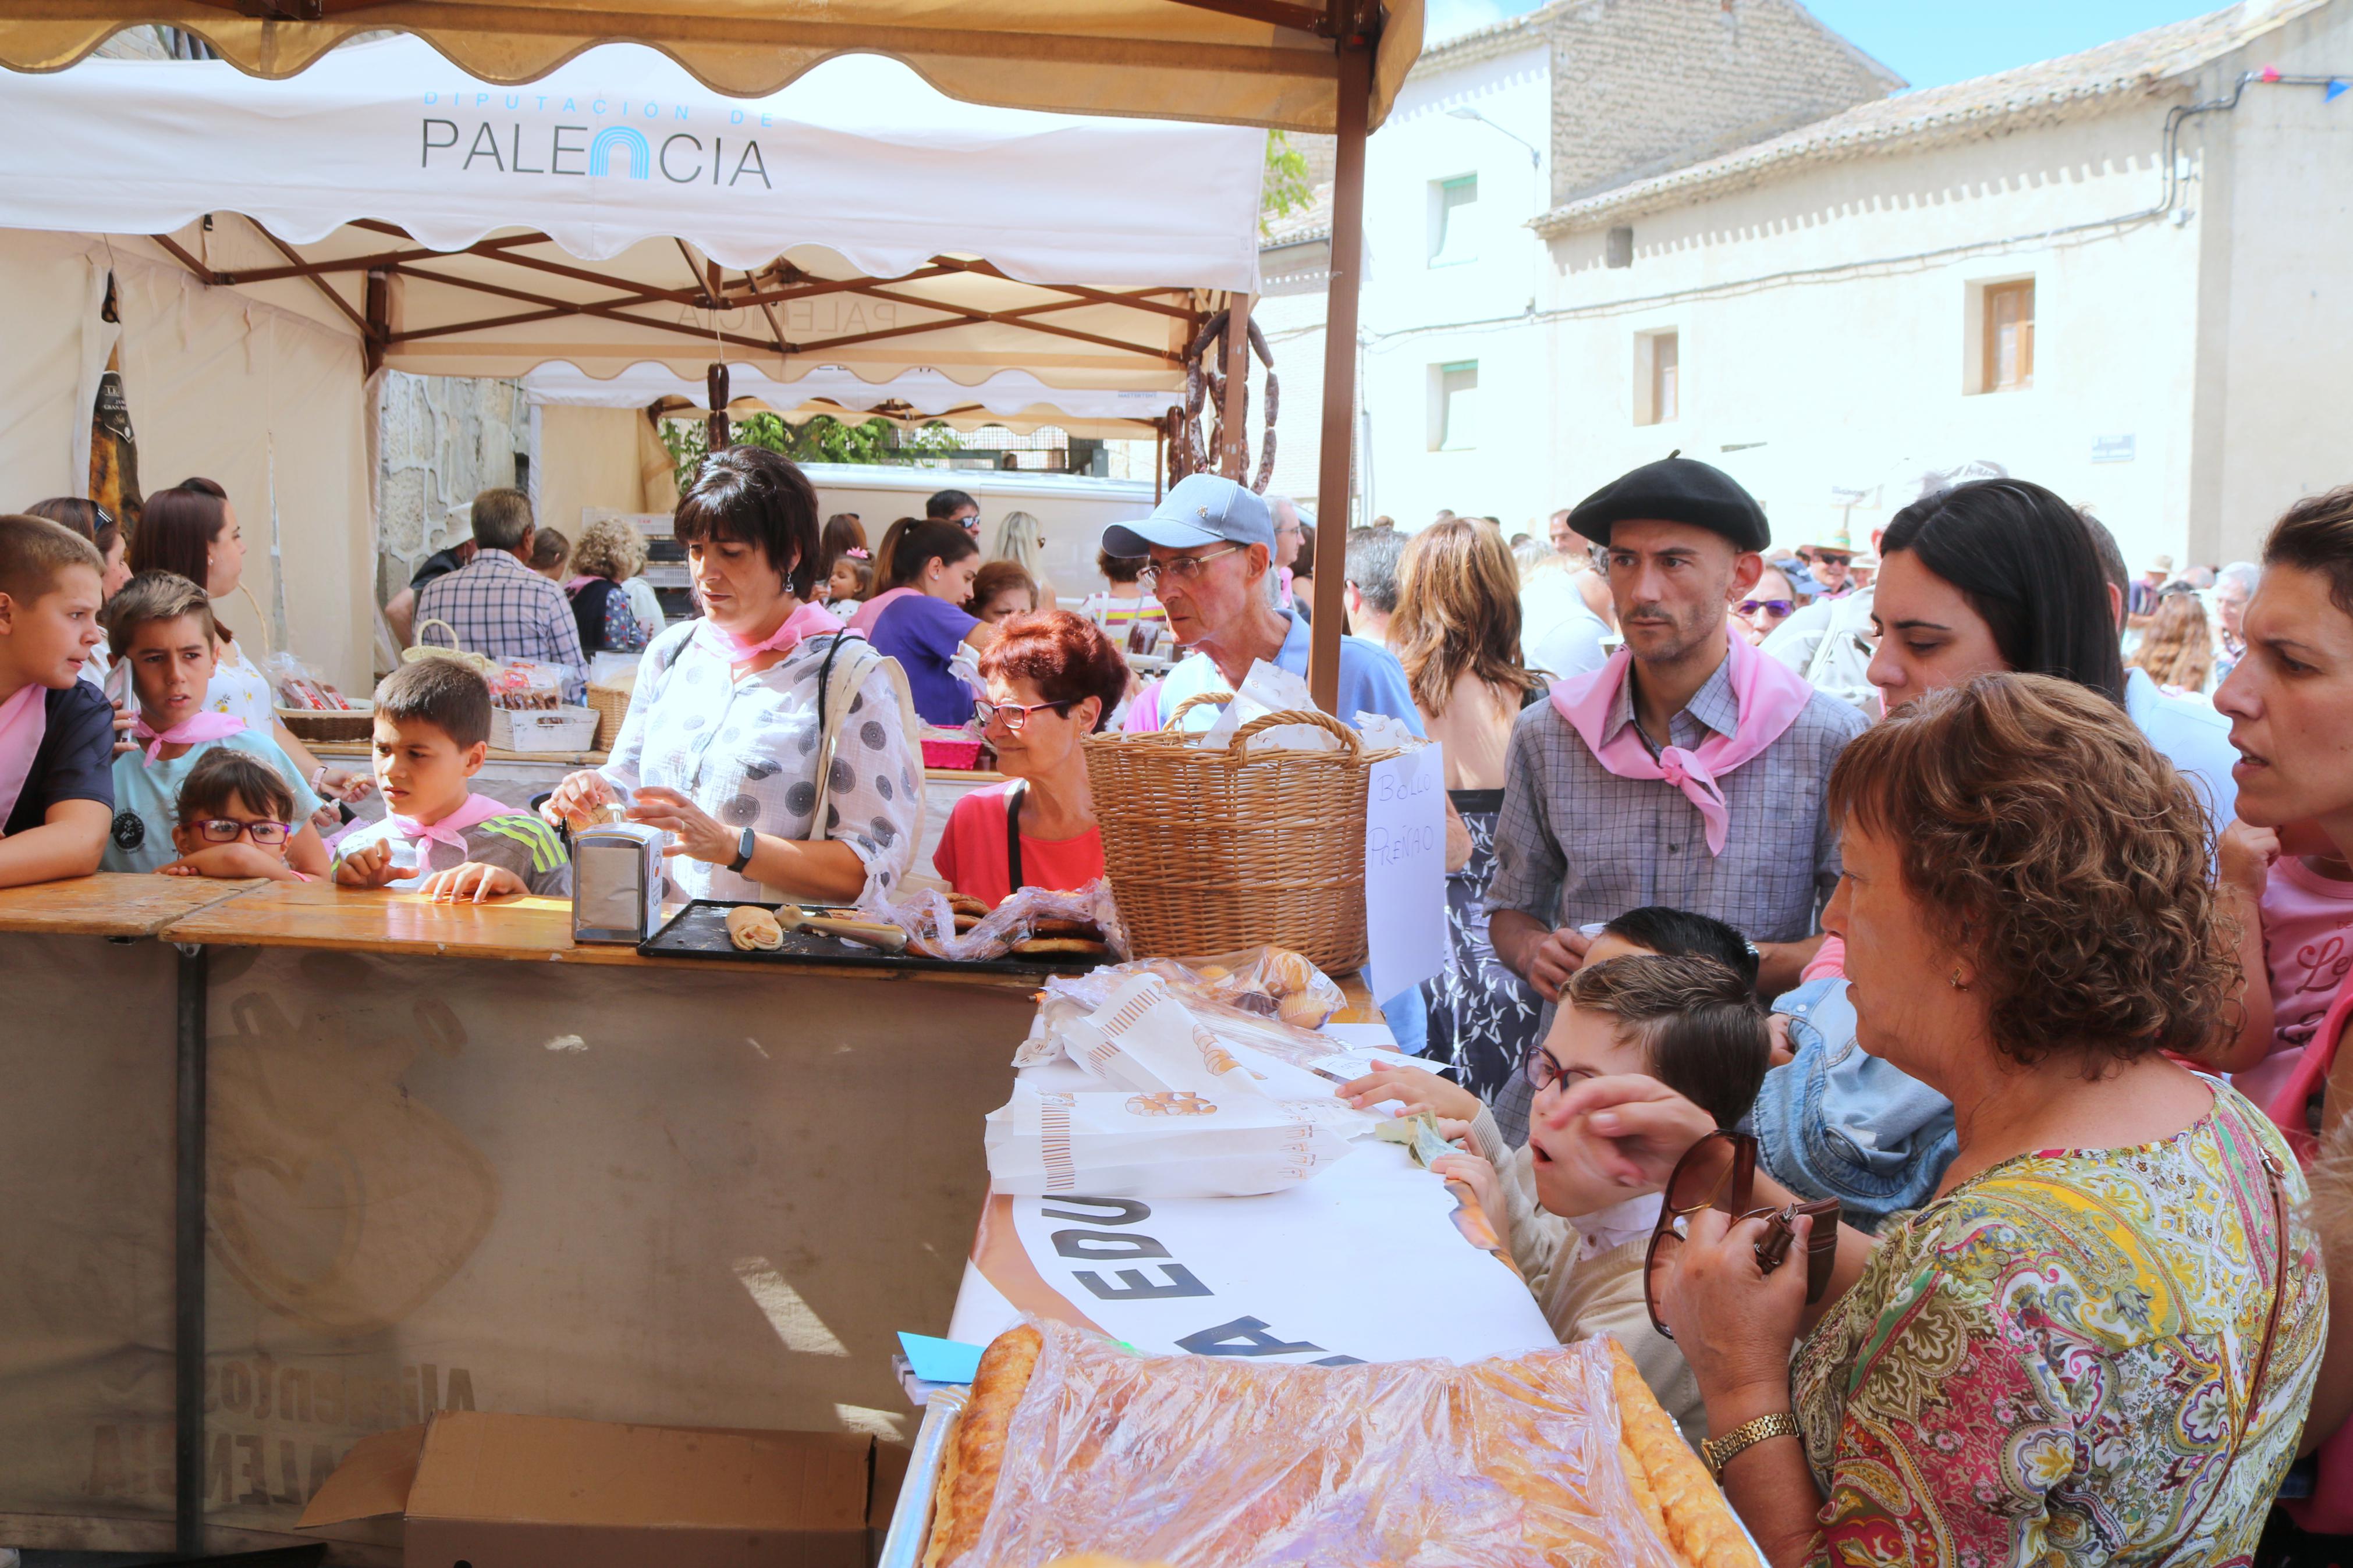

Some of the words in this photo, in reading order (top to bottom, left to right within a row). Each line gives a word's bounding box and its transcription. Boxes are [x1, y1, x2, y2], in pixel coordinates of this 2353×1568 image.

[424, 92, 689, 120] DIPUTACIÓN
[730, 109, 773, 127] DE
[1378, 774, 1431, 801] BOLLO
[1366, 825, 1434, 869] PREÑAO
